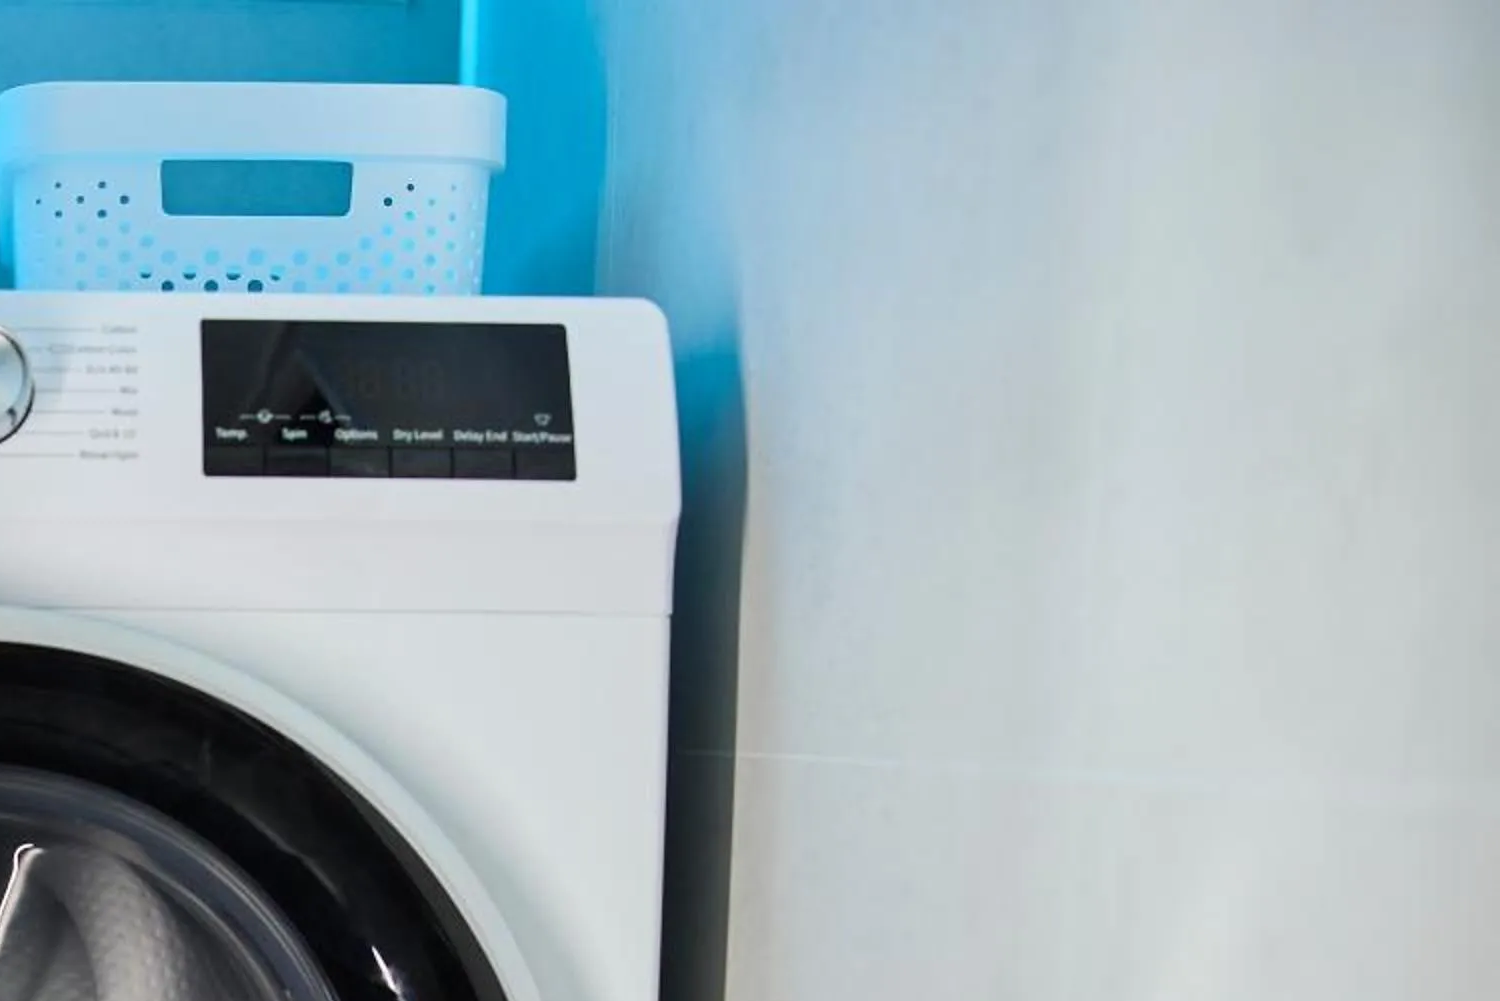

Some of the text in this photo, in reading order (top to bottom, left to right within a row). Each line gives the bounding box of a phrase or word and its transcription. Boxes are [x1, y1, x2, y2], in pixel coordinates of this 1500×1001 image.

[282, 427, 308, 442] Spin
[334, 427, 379, 442] Options
[393, 428, 444, 443] Dry Level
[453, 428, 509, 444] Delay End
